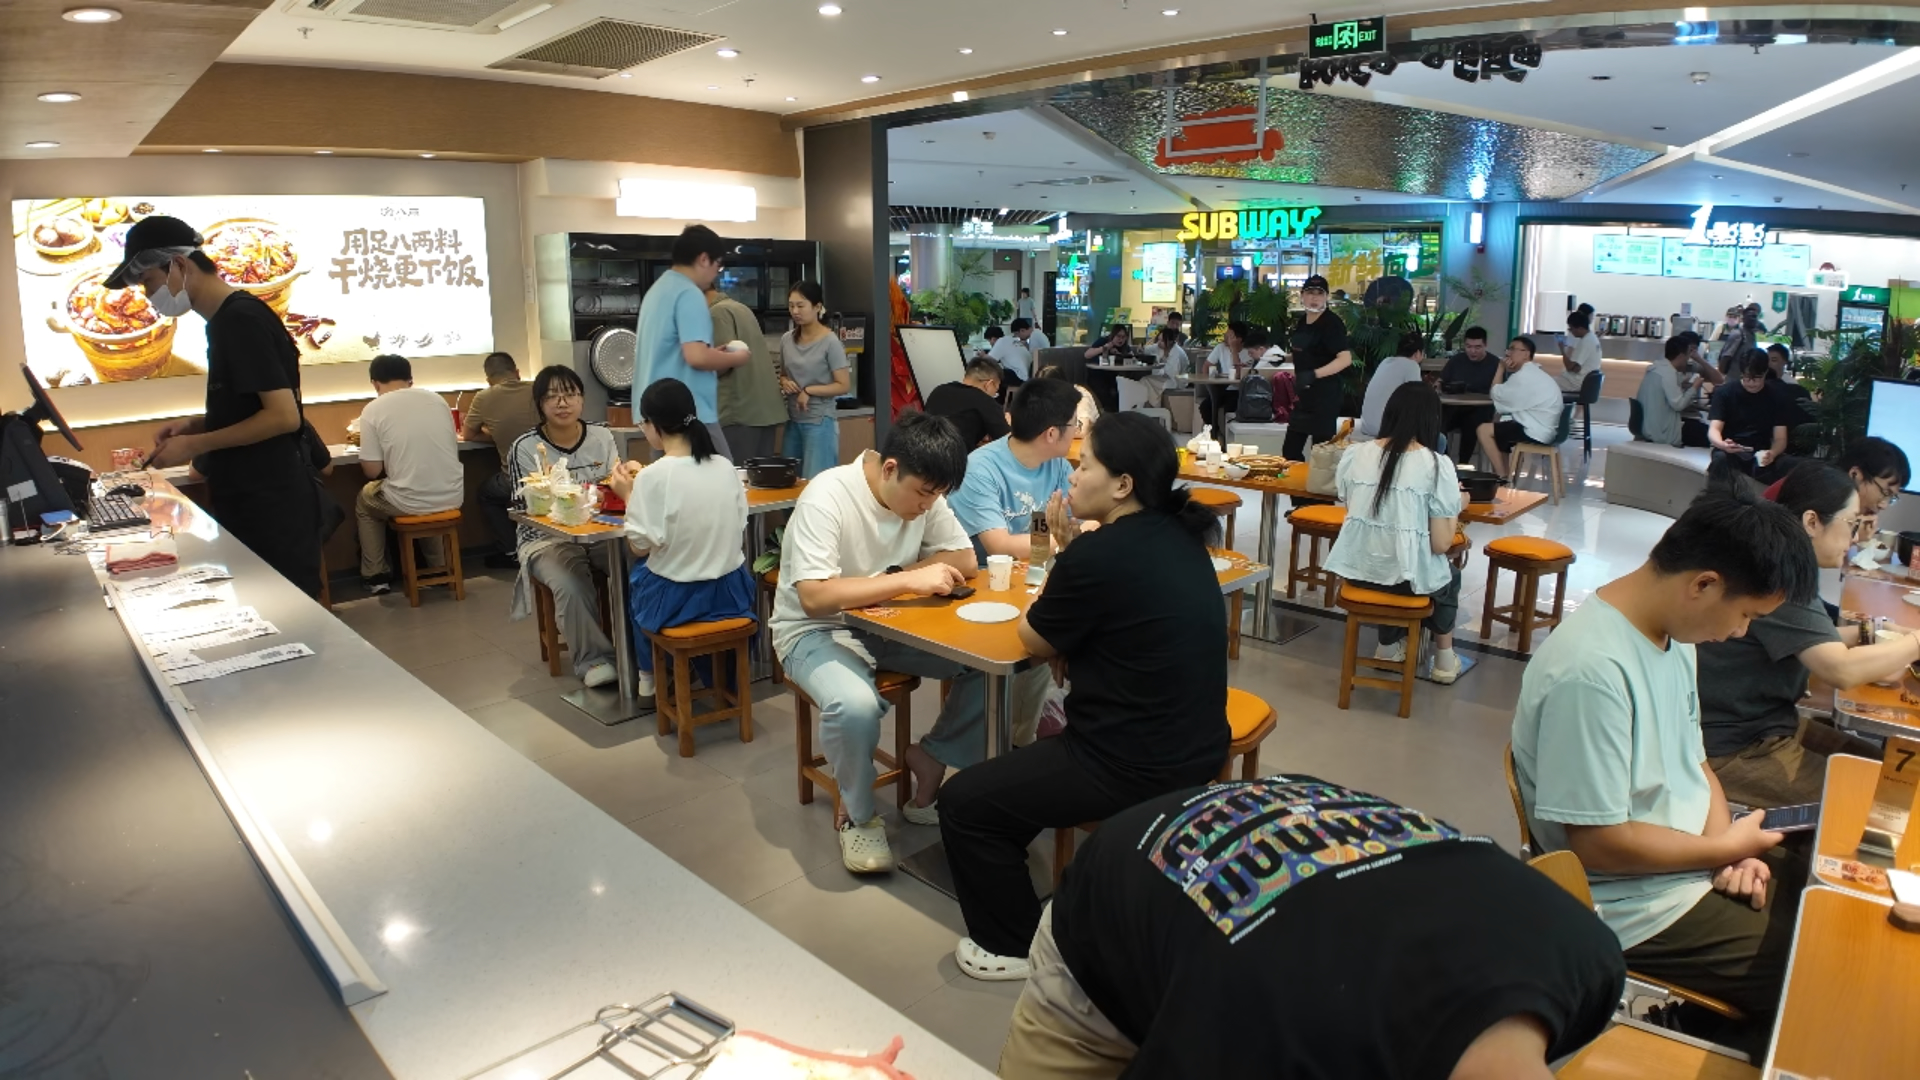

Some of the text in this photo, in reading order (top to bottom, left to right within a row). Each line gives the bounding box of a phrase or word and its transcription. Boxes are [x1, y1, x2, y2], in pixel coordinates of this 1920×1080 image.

[1358, 29, 1377, 42] EXIT
[1176, 206, 1322, 242] SUBWAY
[340, 227, 463, 256] 用足八两料
[328, 254, 484, 295] 干烧更下饭
[1033, 518, 1048, 533] 15
[1895, 748, 1916, 773] 7
